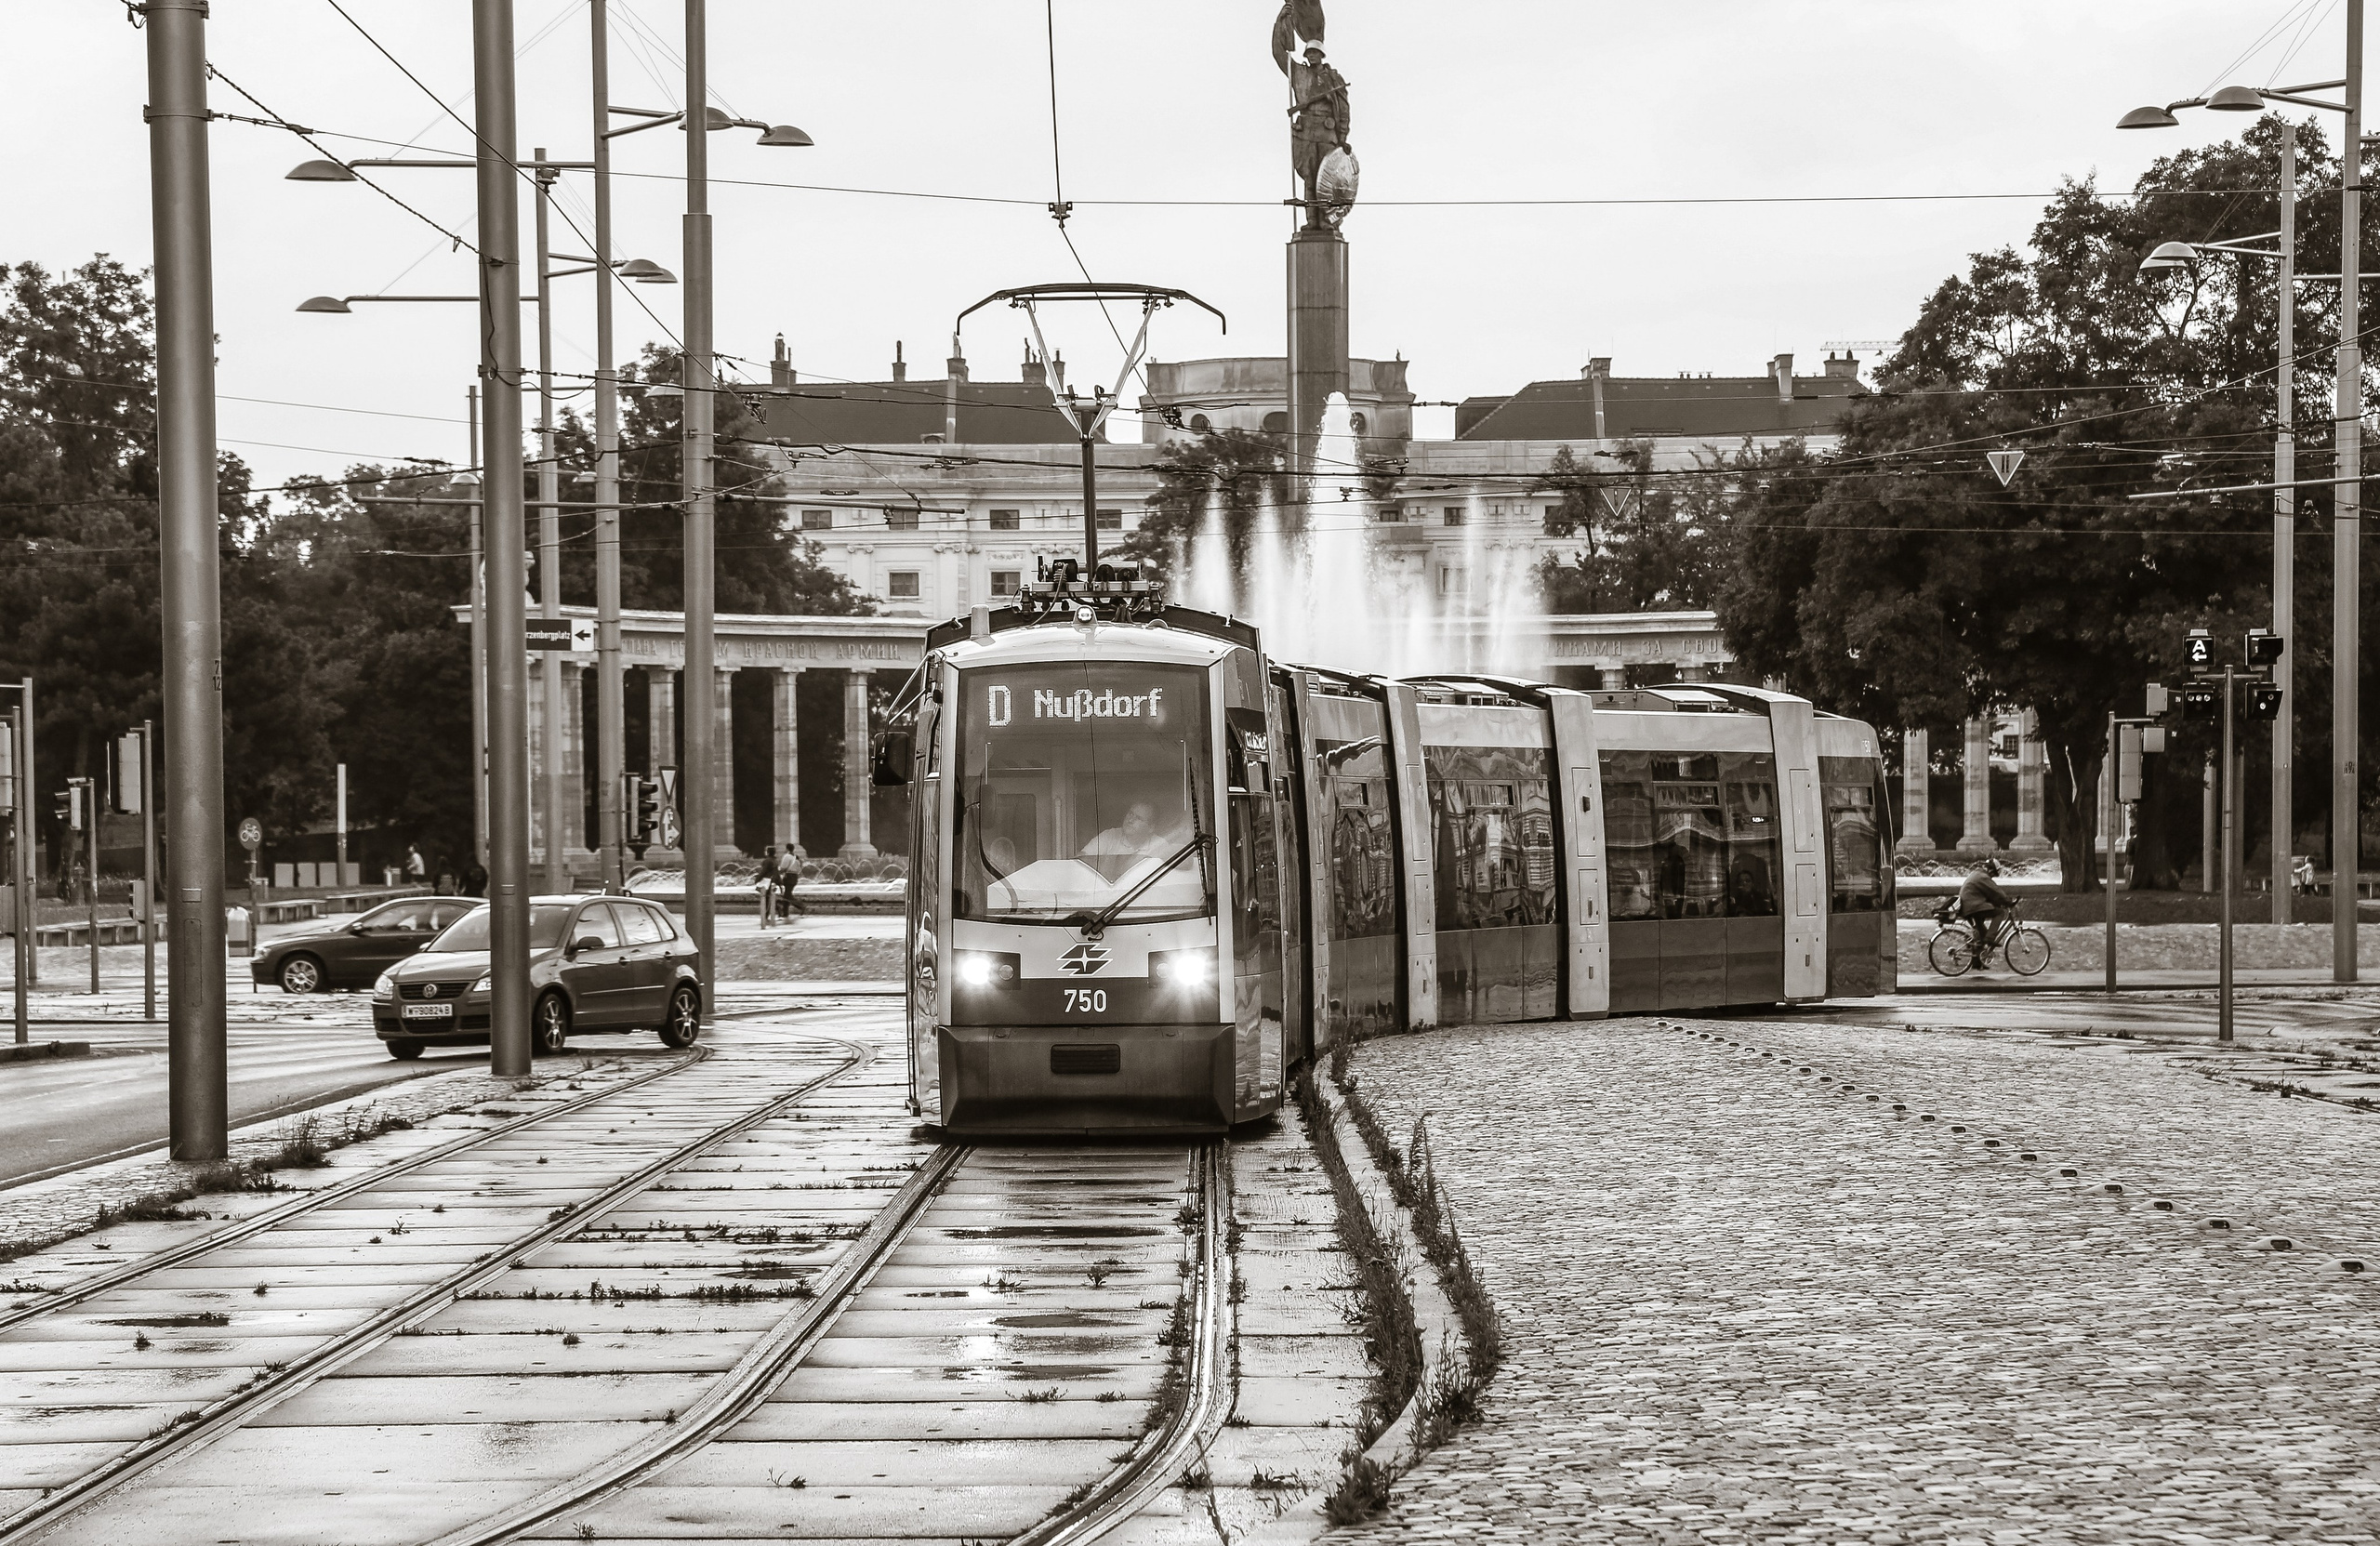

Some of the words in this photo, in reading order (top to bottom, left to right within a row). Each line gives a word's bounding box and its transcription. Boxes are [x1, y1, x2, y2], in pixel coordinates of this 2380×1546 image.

[744, 641, 819, 659] КРАСНОЙ
[1641, 640, 1663, 656] ЗА
[1681, 638, 1724, 654] СВО
[2192, 640, 2206, 653] A
[988, 685, 1012, 727] D
[1034, 687, 1163, 722] Nußdorf
[1064, 988, 1107, 1013] 750
